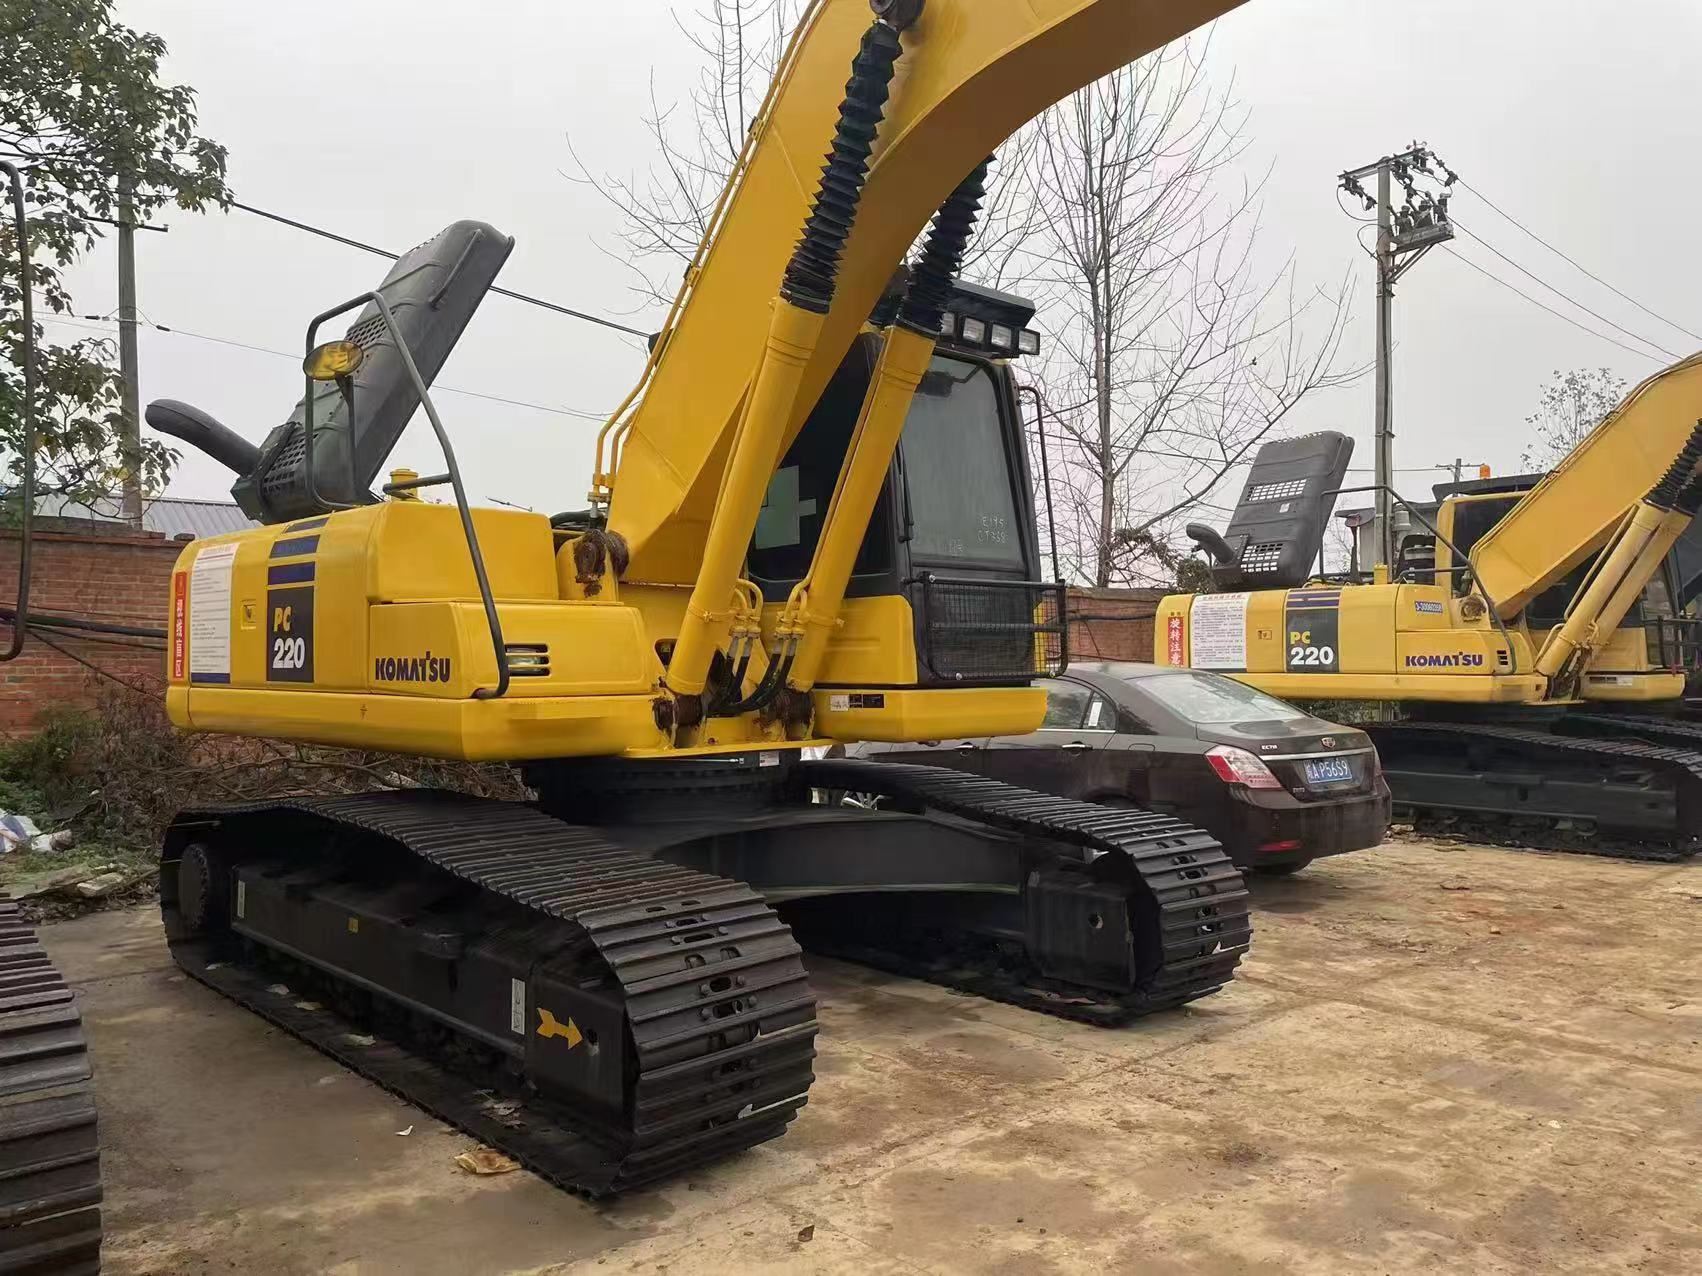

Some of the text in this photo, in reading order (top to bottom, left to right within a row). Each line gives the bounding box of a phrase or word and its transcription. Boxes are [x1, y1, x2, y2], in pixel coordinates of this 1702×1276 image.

[273, 605, 292, 632] PC
[1290, 630, 1311, 645] PC
[271, 636, 306, 669] 220
[1290, 646, 1334, 666] 220
[1405, 652, 1484, 667] KOMATSU
[375, 650, 451, 683] KOMATSU
